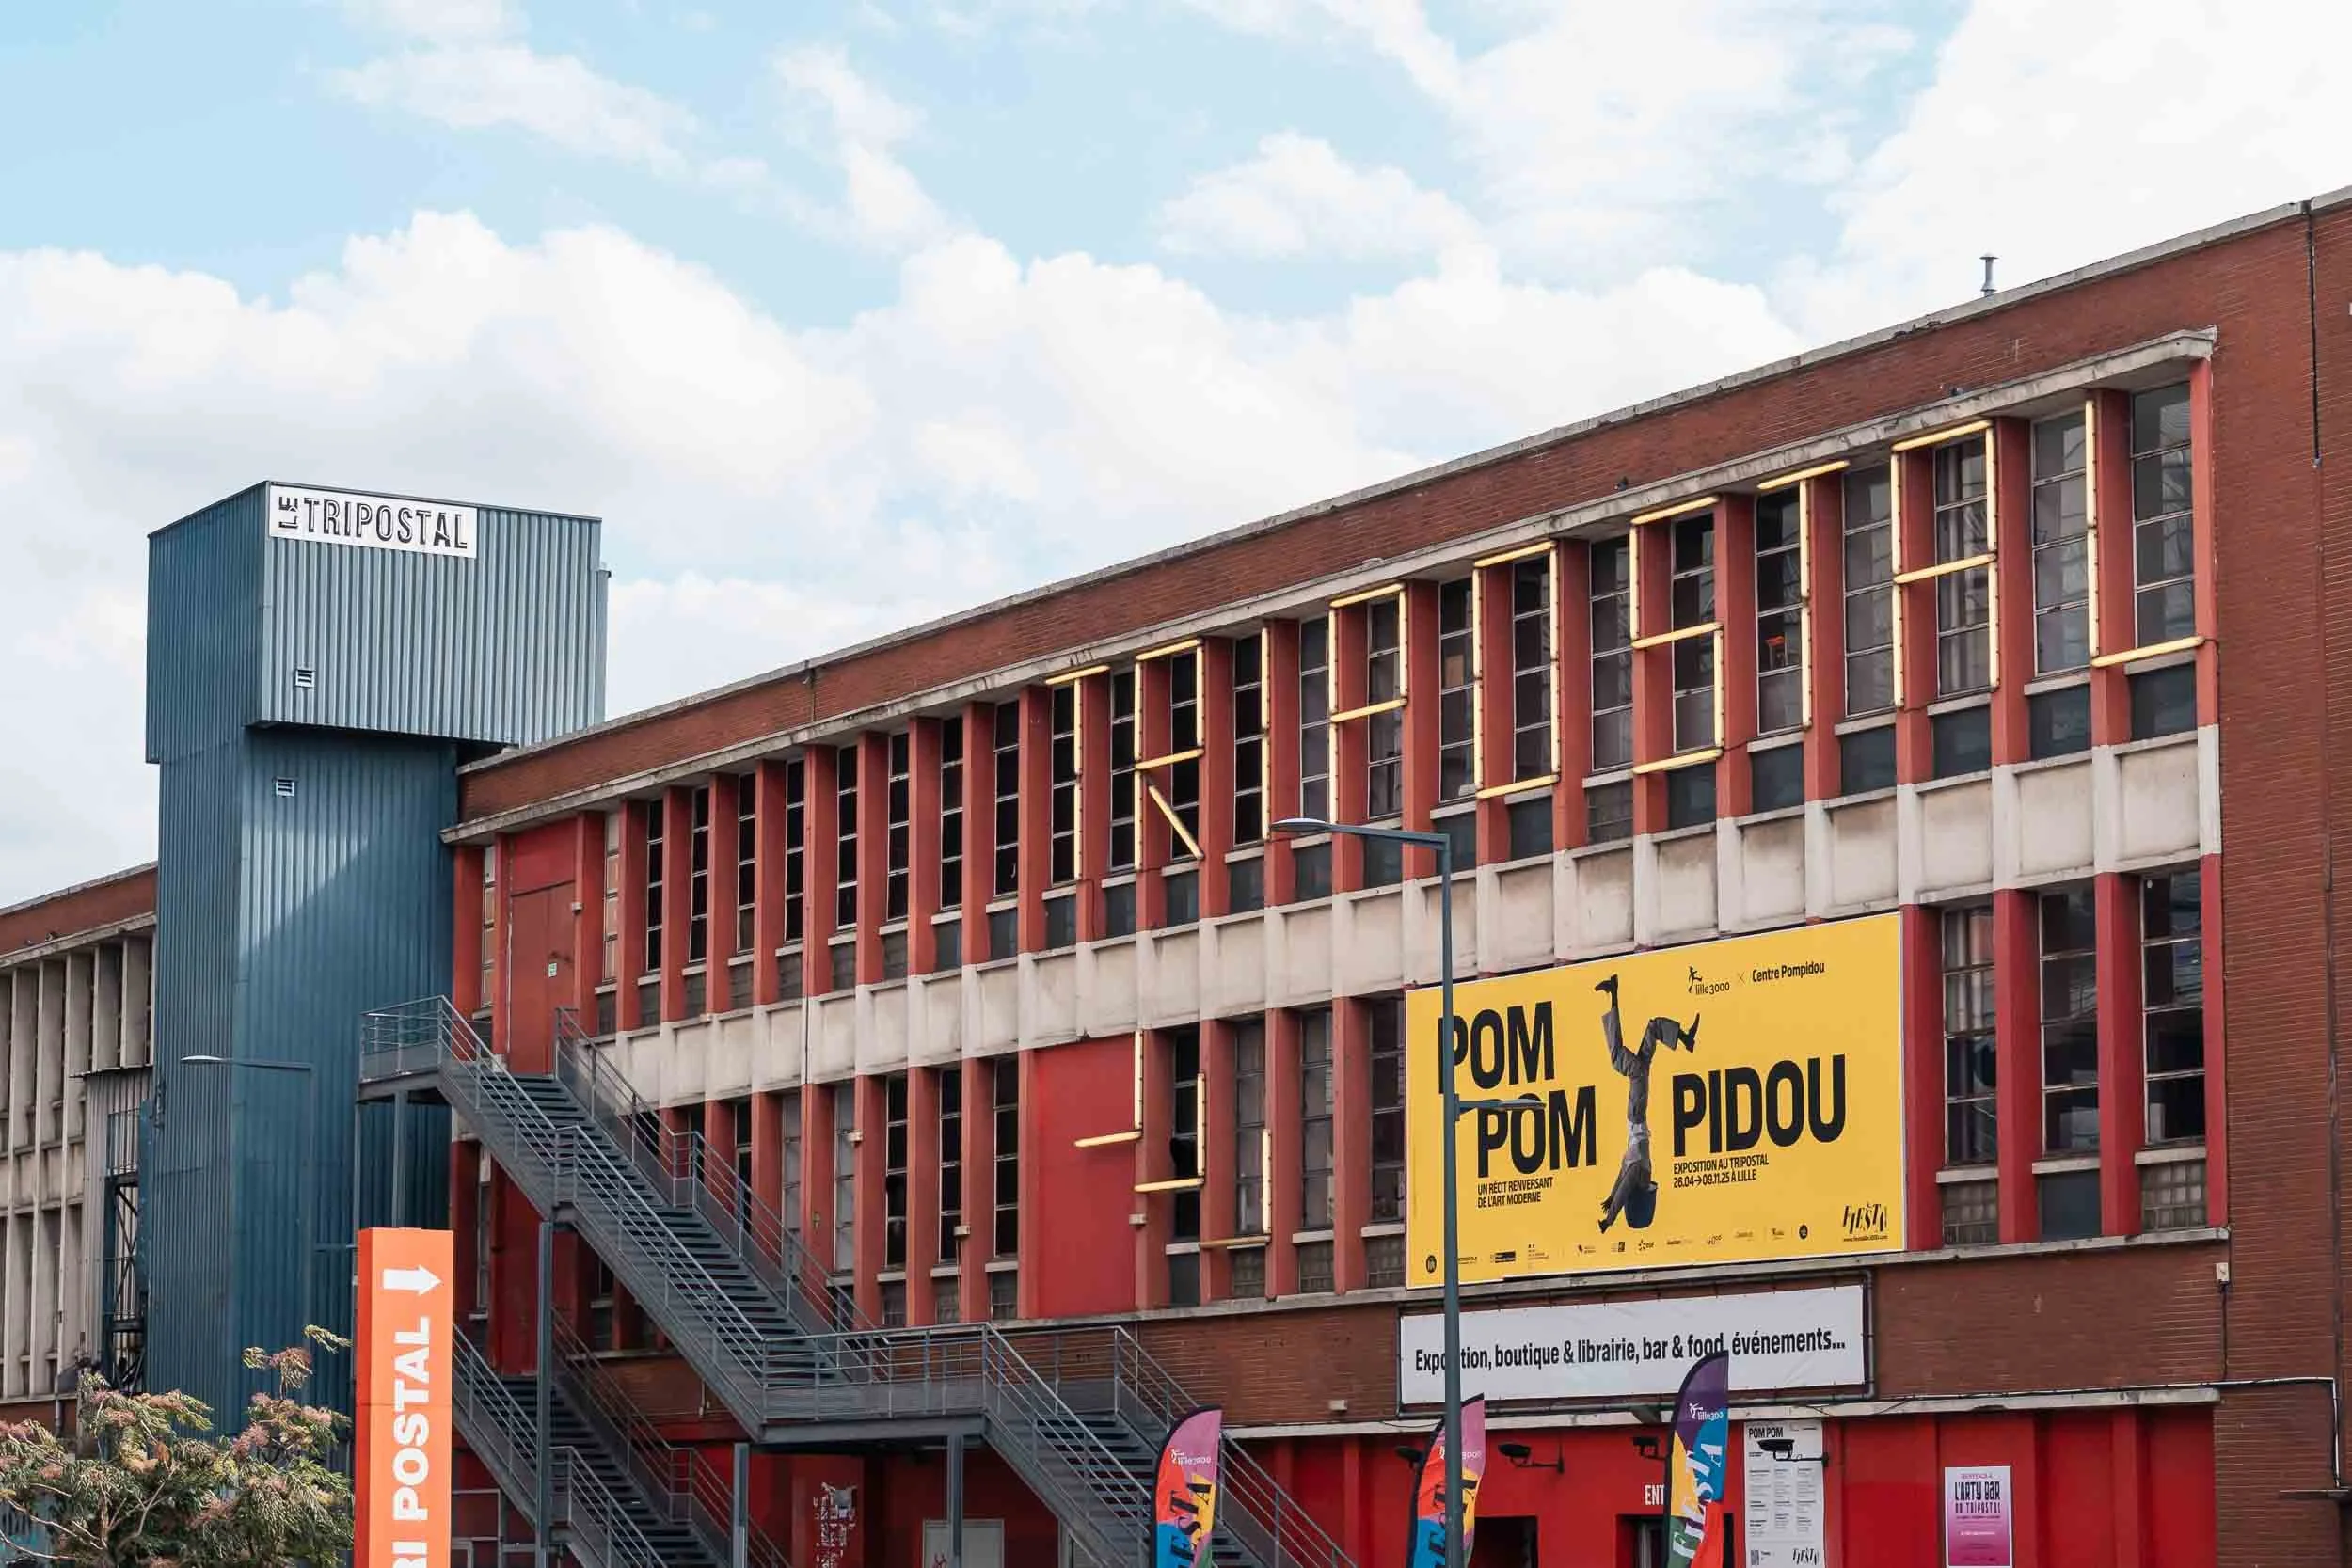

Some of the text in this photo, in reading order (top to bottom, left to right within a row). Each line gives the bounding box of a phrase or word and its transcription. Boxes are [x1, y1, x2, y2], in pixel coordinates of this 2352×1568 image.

[278, 496, 298, 529] LE
[304, 497, 468, 549] TRIPOSTAL
[1752, 960, 1825, 983] Centre Pompidou
[1695, 981, 1729, 995] lille3000
[1438, 1000, 1554, 1094] POM
[1673, 1053, 1846, 1157] PIDOU
[1477, 1085, 1597, 1178] POM
[1674, 1152, 1770, 1175] EXPOSITION AU TRIPOSTAL
[1738, 1168, 1756, 1182] LILLE
[1477, 1176, 1553, 1196] UN RÉCIT RENVERSANT
[1477, 1191, 1541, 1209] DE L'ART MODERNE
[1495, 1343, 1560, 1370] boutique
[1563, 1339, 1574, 1364] &
[1577, 1337, 1640, 1364] librairie,
[1643, 1336, 1668, 1361] bar
[1671, 1334, 1684, 1358] &
[1732, 1327, 1846, 1355] événements...
[392, 1316, 430, 1521] POSTAL
[1749, 1427, 1766, 1439] POM
[1767, 1426, 1784, 1438] POM
